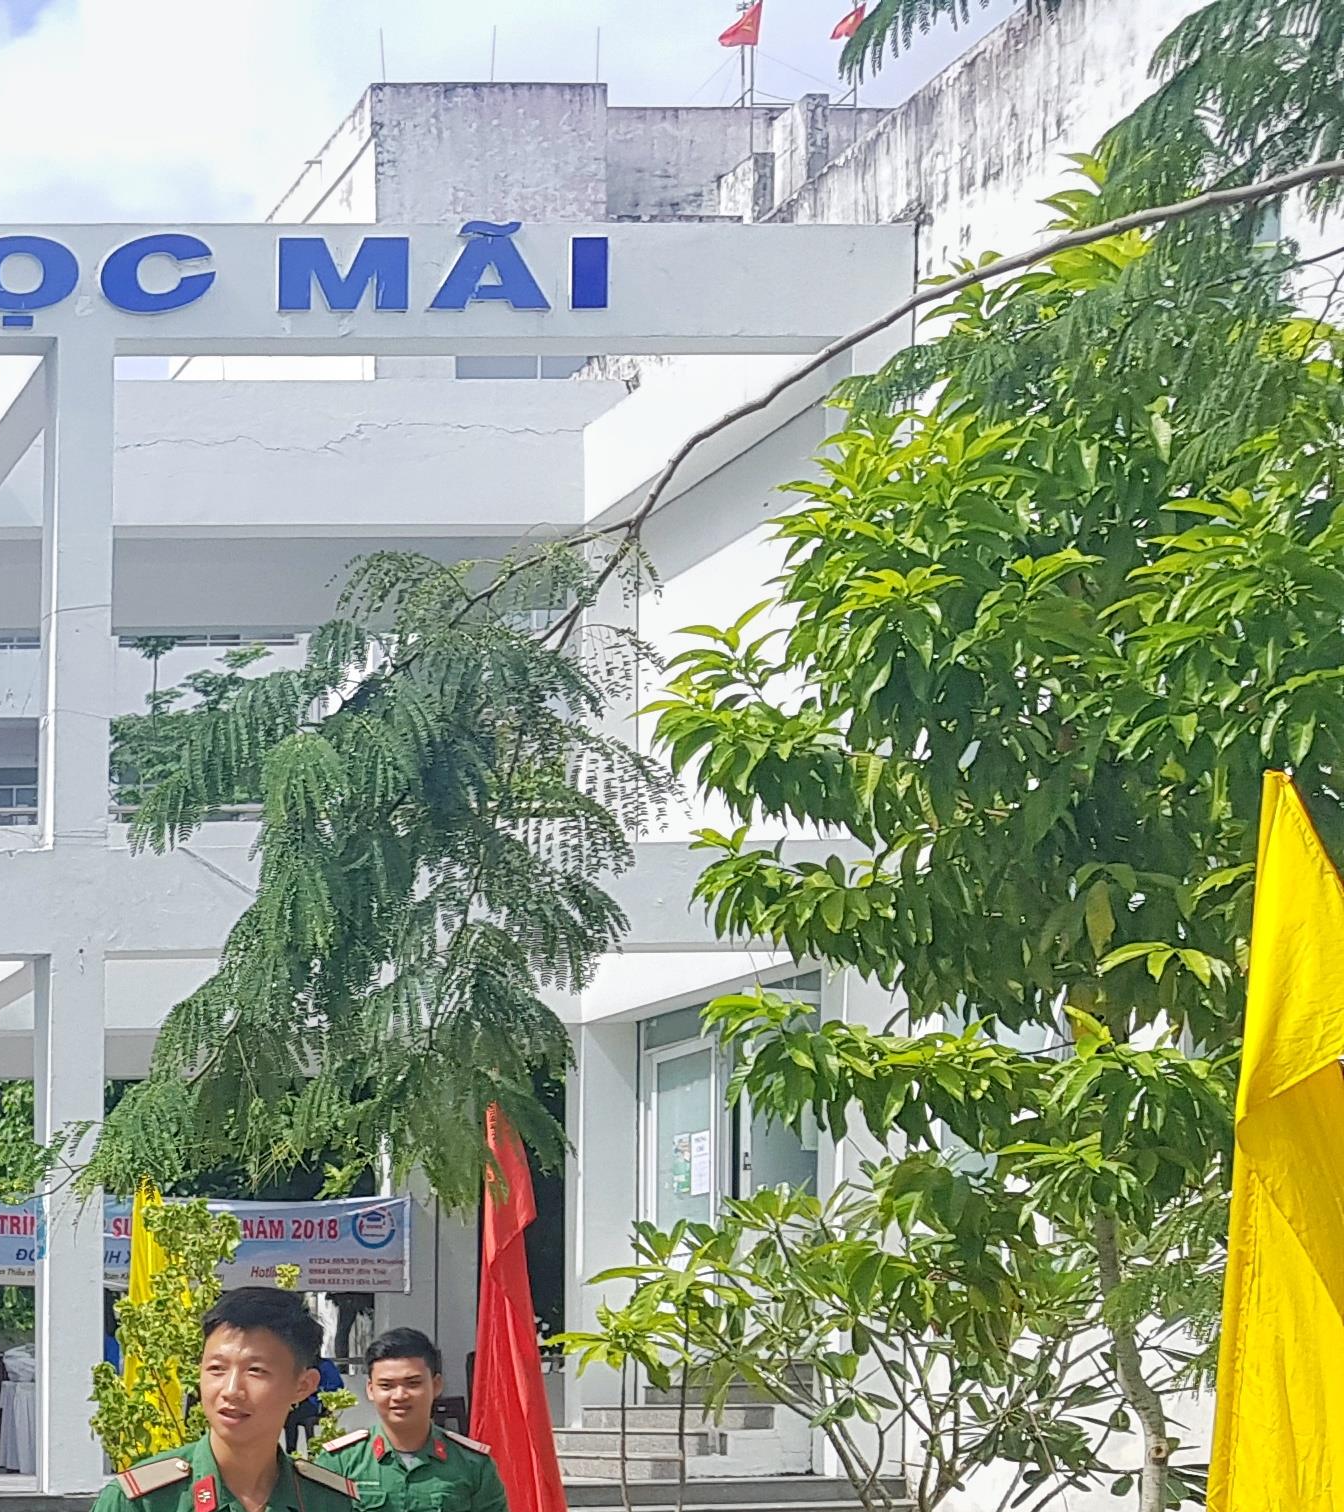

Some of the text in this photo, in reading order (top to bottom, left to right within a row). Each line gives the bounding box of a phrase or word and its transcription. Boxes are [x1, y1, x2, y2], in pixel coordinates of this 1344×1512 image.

[276, 220, 610, 313] MÃI
[243, 1216, 284, 1239] NĂM
[291, 1219, 338, 1240] 2018
